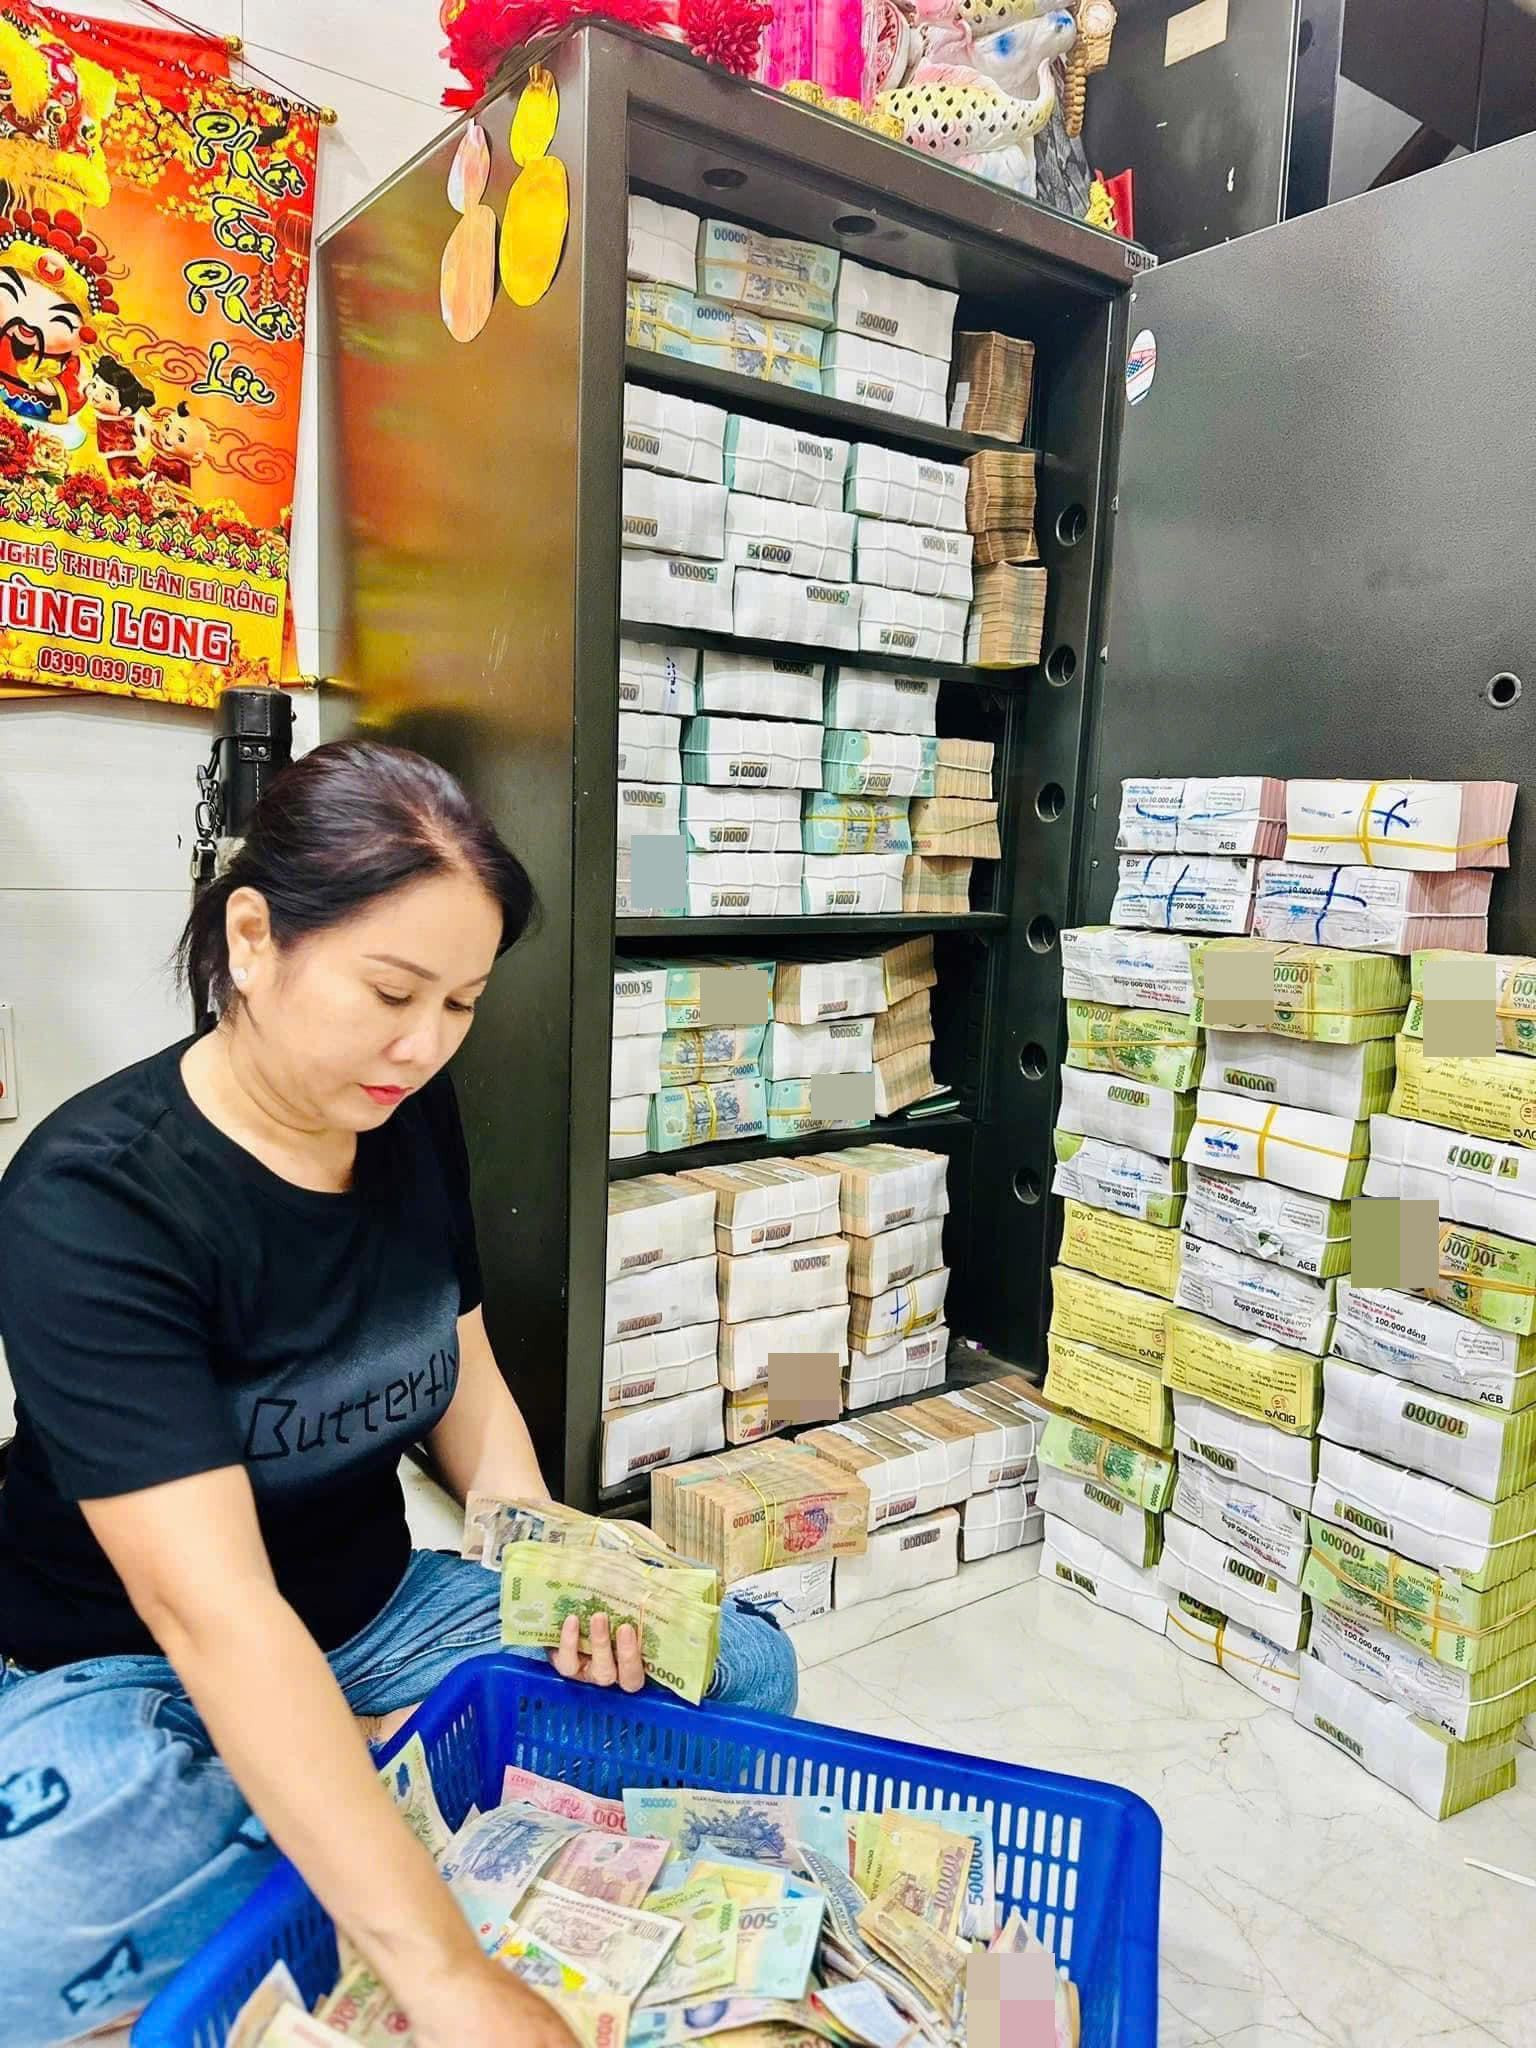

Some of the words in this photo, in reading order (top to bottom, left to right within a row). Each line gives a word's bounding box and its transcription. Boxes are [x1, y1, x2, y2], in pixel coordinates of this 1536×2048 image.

[714, 227, 753, 246] 00000
[1127, 250, 1142, 268] TSD
[860, 311, 898, 334] 500000
[669, 562, 716, 580] 500000
[62, 550, 138, 590] THUẬT
[140, 568, 184, 599] LÂN
[189, 578, 217, 603] SƯ
[221, 581, 278, 617] RỒNG
[806, 585, 848, 604] 500000
[0, 573, 102, 643] ÙNG
[110, 602, 233, 666] LONG
[38, 647, 87, 676] 0399
[89, 655, 128, 683] 039
[129, 662, 163, 690] 591
[623, 790, 664, 805] 500000
[710, 830, 749, 843] 500000
[1218, 841, 1237, 850] ACB
[1063, 934, 1078, 943] ACB
[830, 1027, 862, 1039] 500000
[1225, 1073, 1275, 1092] 100000
[1108, 1085, 1146, 1105] 100000
[1185, 1241, 1201, 1253] ACB
[1296, 1260, 1317, 1272] ACB
[1233, 1300, 1251, 1312] đồng
[1251, 1306, 1279, 1320] 100.000
[1374, 1316, 1406, 1334] 100.000
[1406, 1327, 1427, 1341] đồng
[1479, 1391, 1504, 1404] ACB
[1405, 1401, 1465, 1435] 100000
[733, 1511, 766, 1529] 200000
